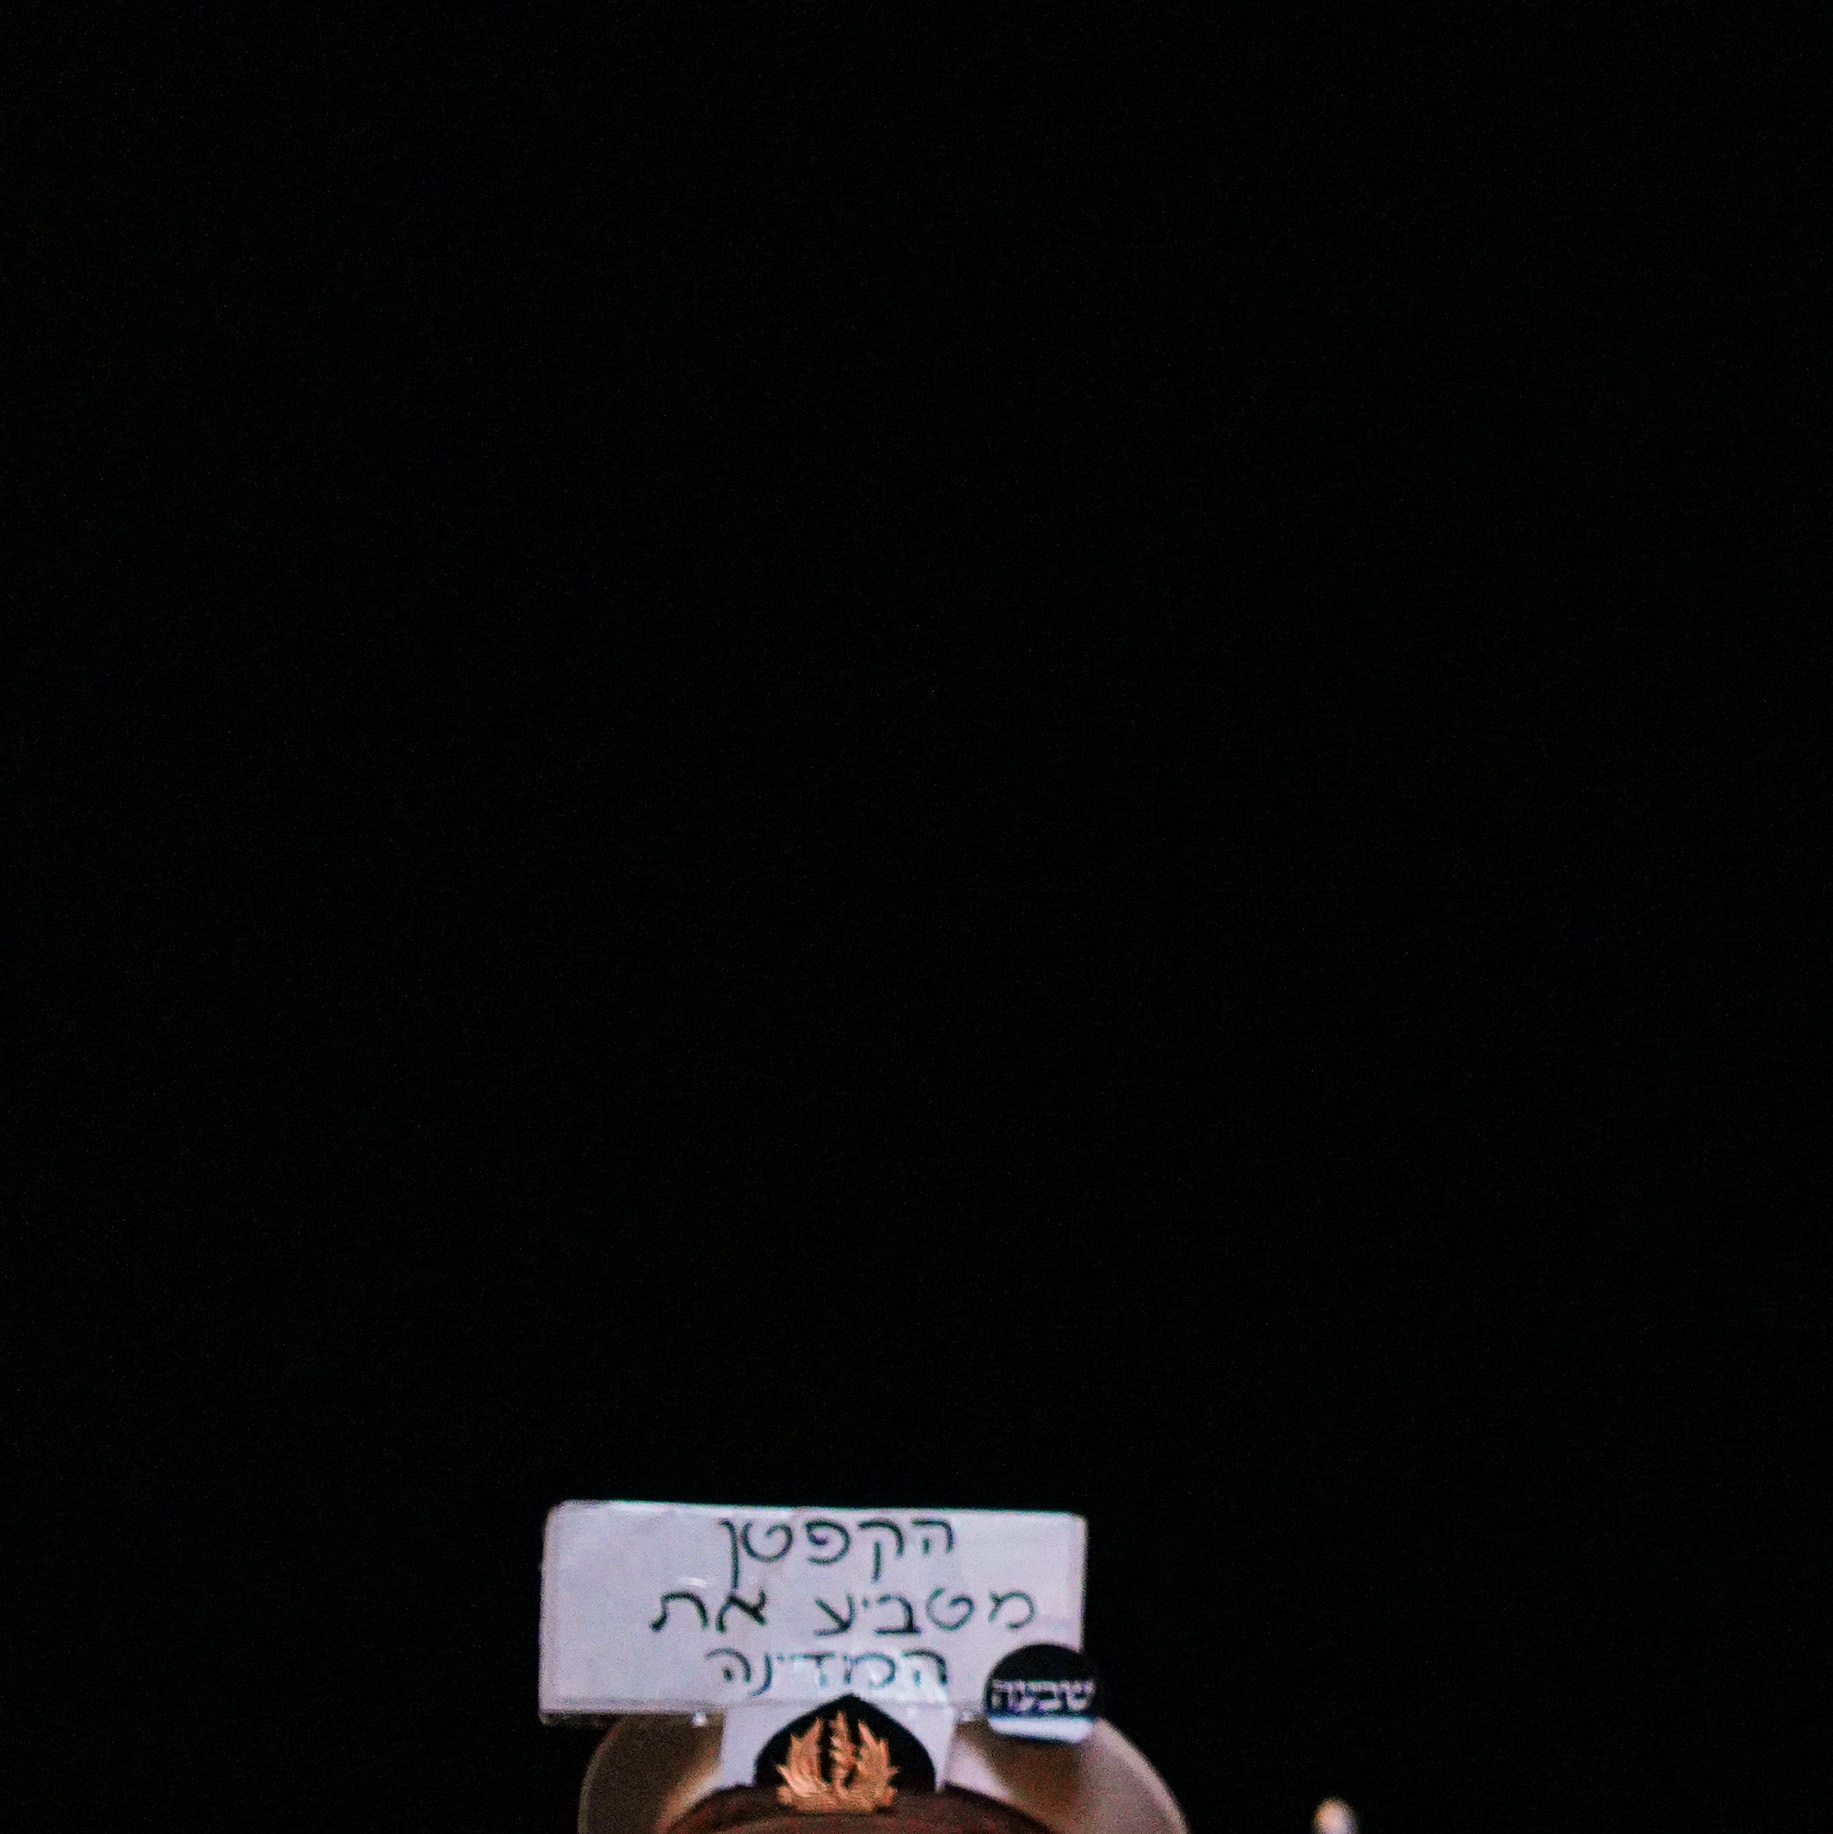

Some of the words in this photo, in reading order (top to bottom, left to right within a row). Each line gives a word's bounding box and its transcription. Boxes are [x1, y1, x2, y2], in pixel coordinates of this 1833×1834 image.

[719, 1517, 956, 1591] הקפטן
[650, 1587, 768, 1635] את
[814, 1587, 1037, 1637] מטביע
